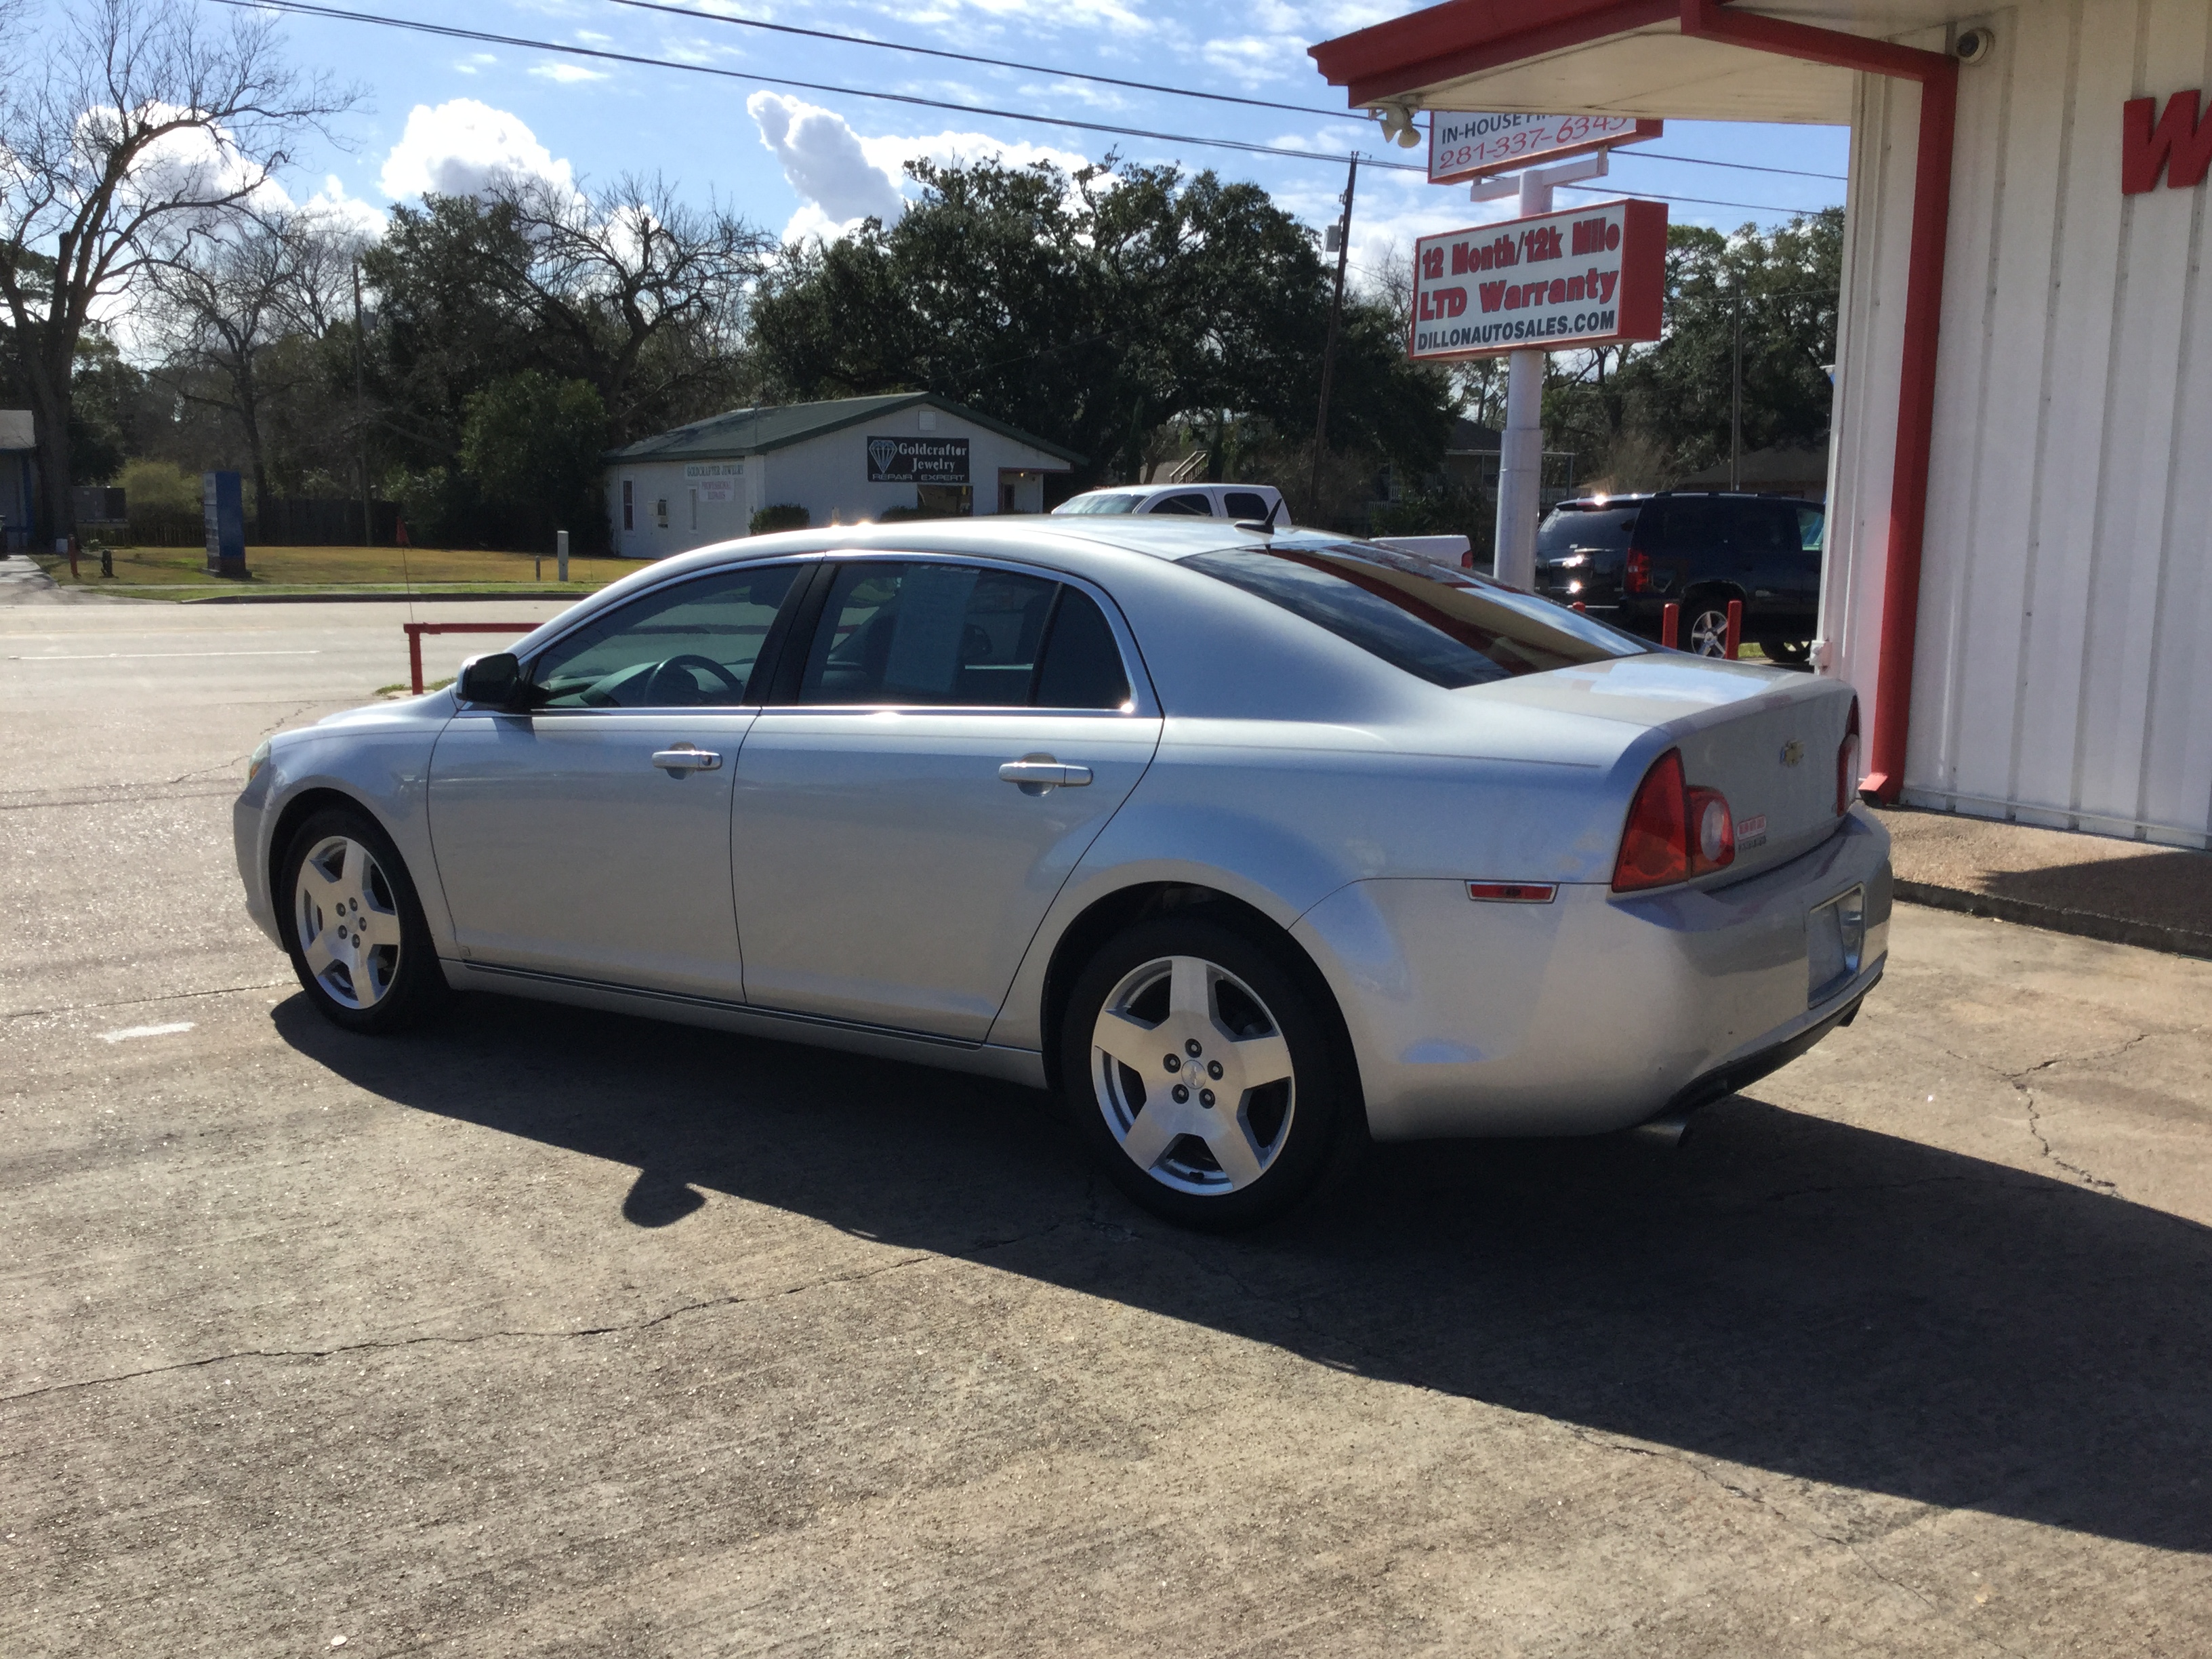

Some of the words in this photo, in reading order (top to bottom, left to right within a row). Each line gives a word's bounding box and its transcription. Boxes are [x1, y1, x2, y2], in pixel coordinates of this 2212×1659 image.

[1442, 114, 1522, 144] IN-HOUSE
[1422, 247, 1444, 280] 12
[1452, 226, 1563, 276] Month/12k
[1572, 217, 1621, 256] Mile
[1420, 287, 1468, 322] LTD
[1479, 268, 1619, 314] Warranty
[1417, 310, 1615, 351] DILLONAUTOSALES.COM
[912, 457, 956, 473] Jewelry
